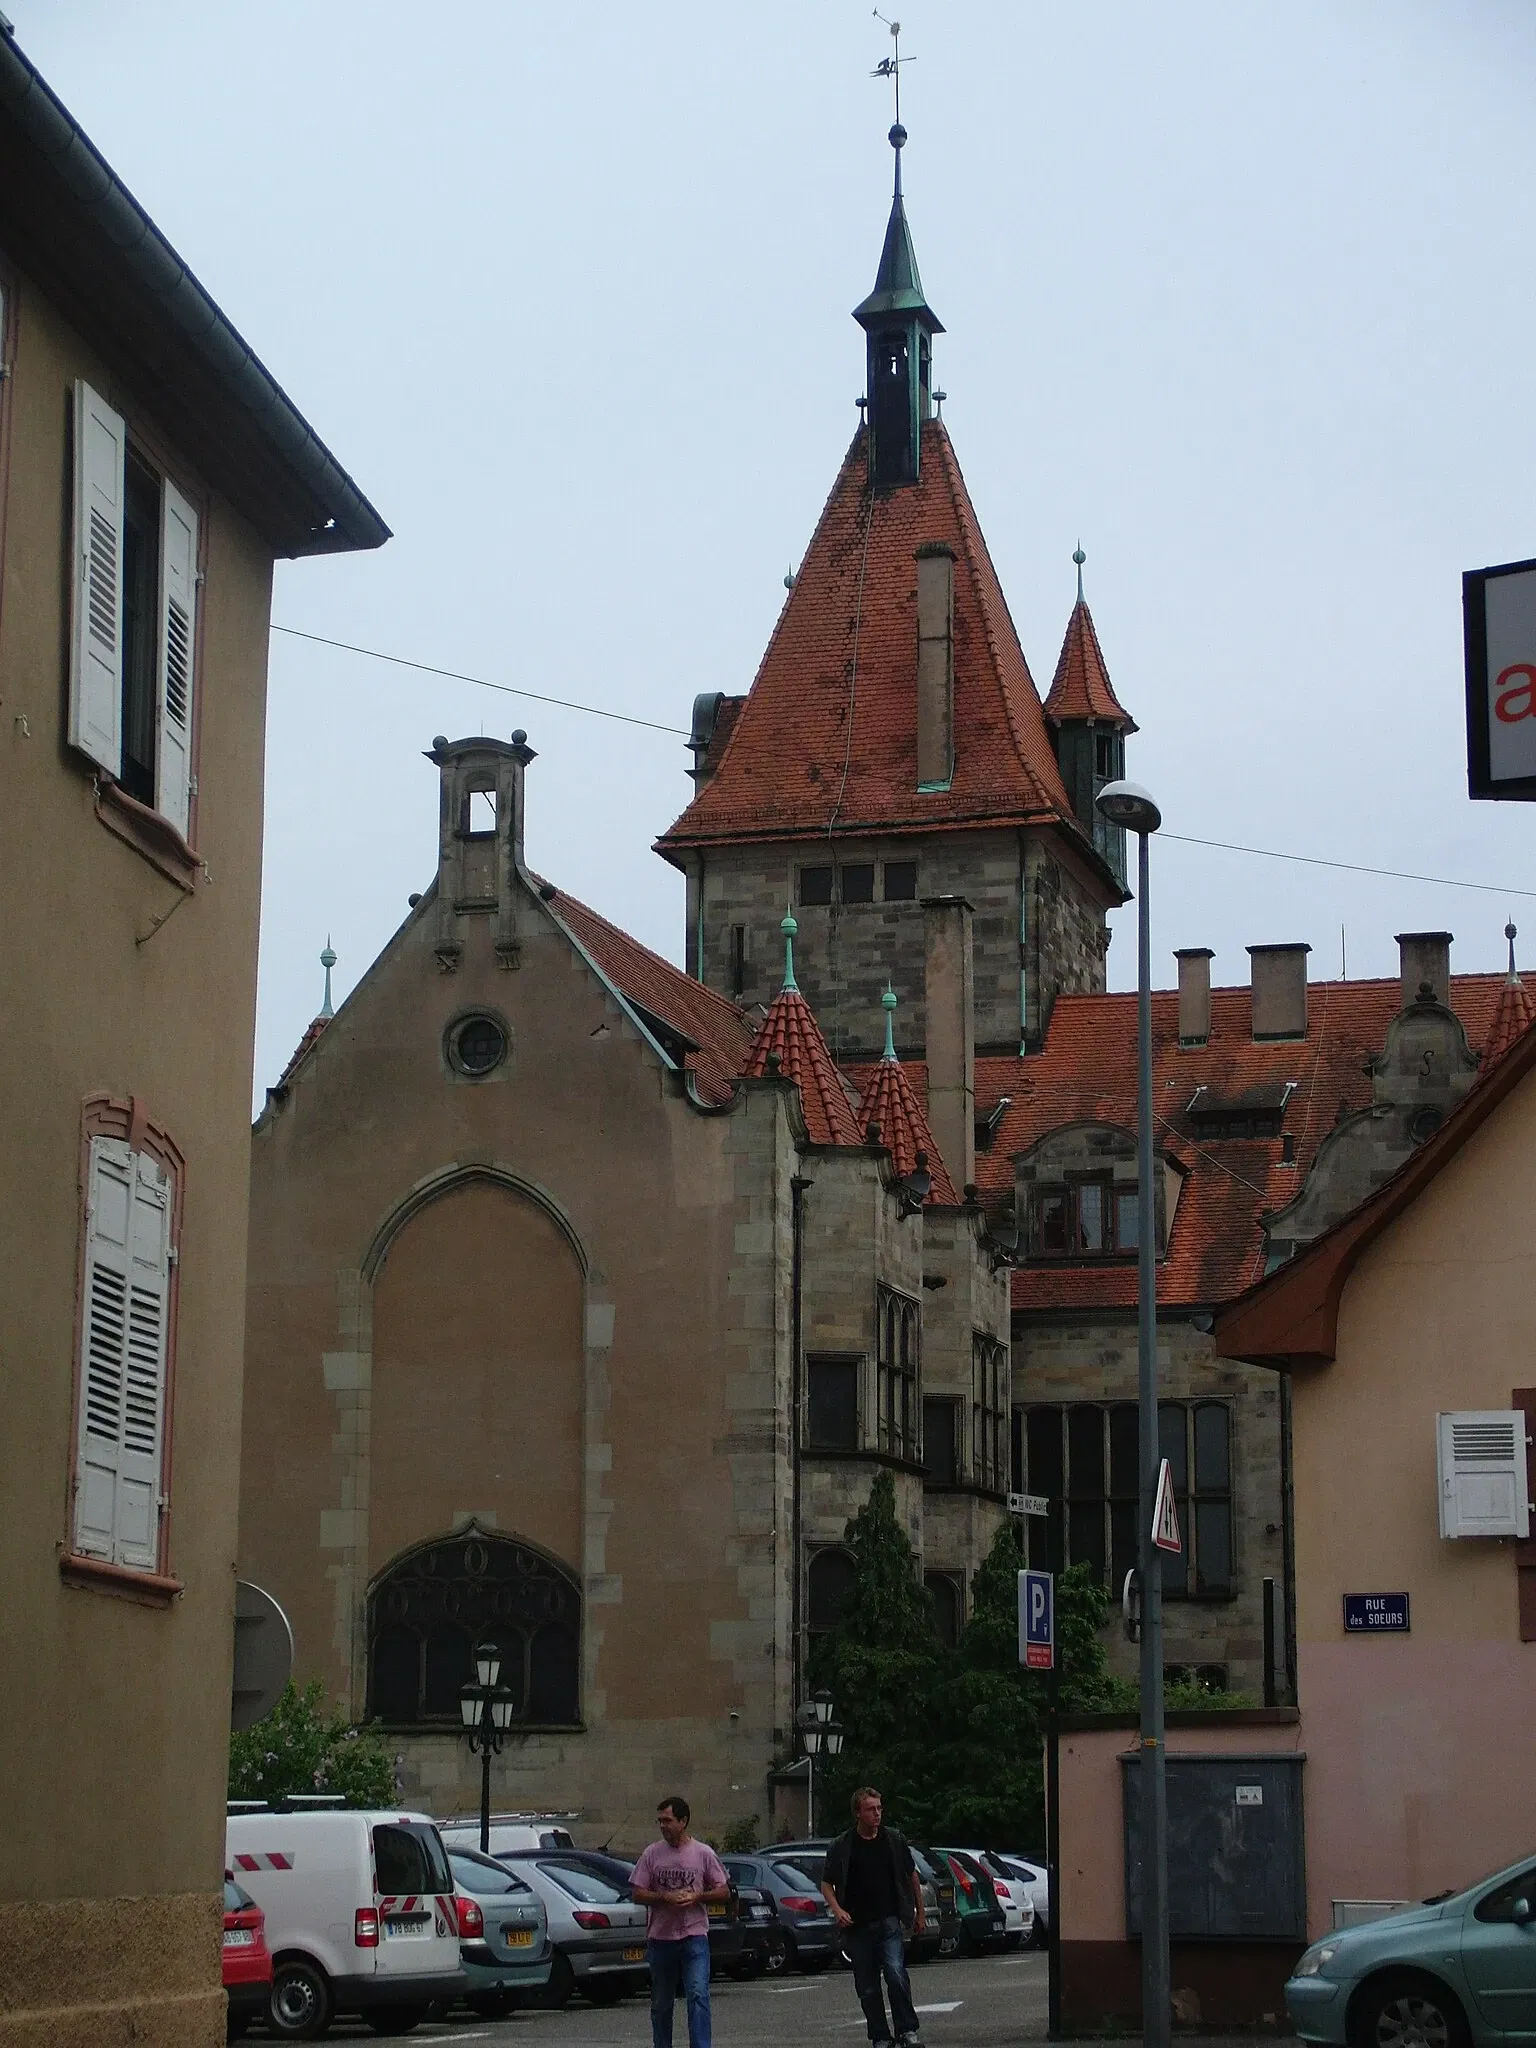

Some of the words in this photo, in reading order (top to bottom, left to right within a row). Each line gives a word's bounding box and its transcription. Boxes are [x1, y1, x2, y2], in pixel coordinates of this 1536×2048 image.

[1031, 1583, 1045, 1632] P
[1365, 1599, 1386, 1610] RUE
[1350, 1614, 1363, 1625] des
[1368, 1612, 1403, 1625] SOEURS
